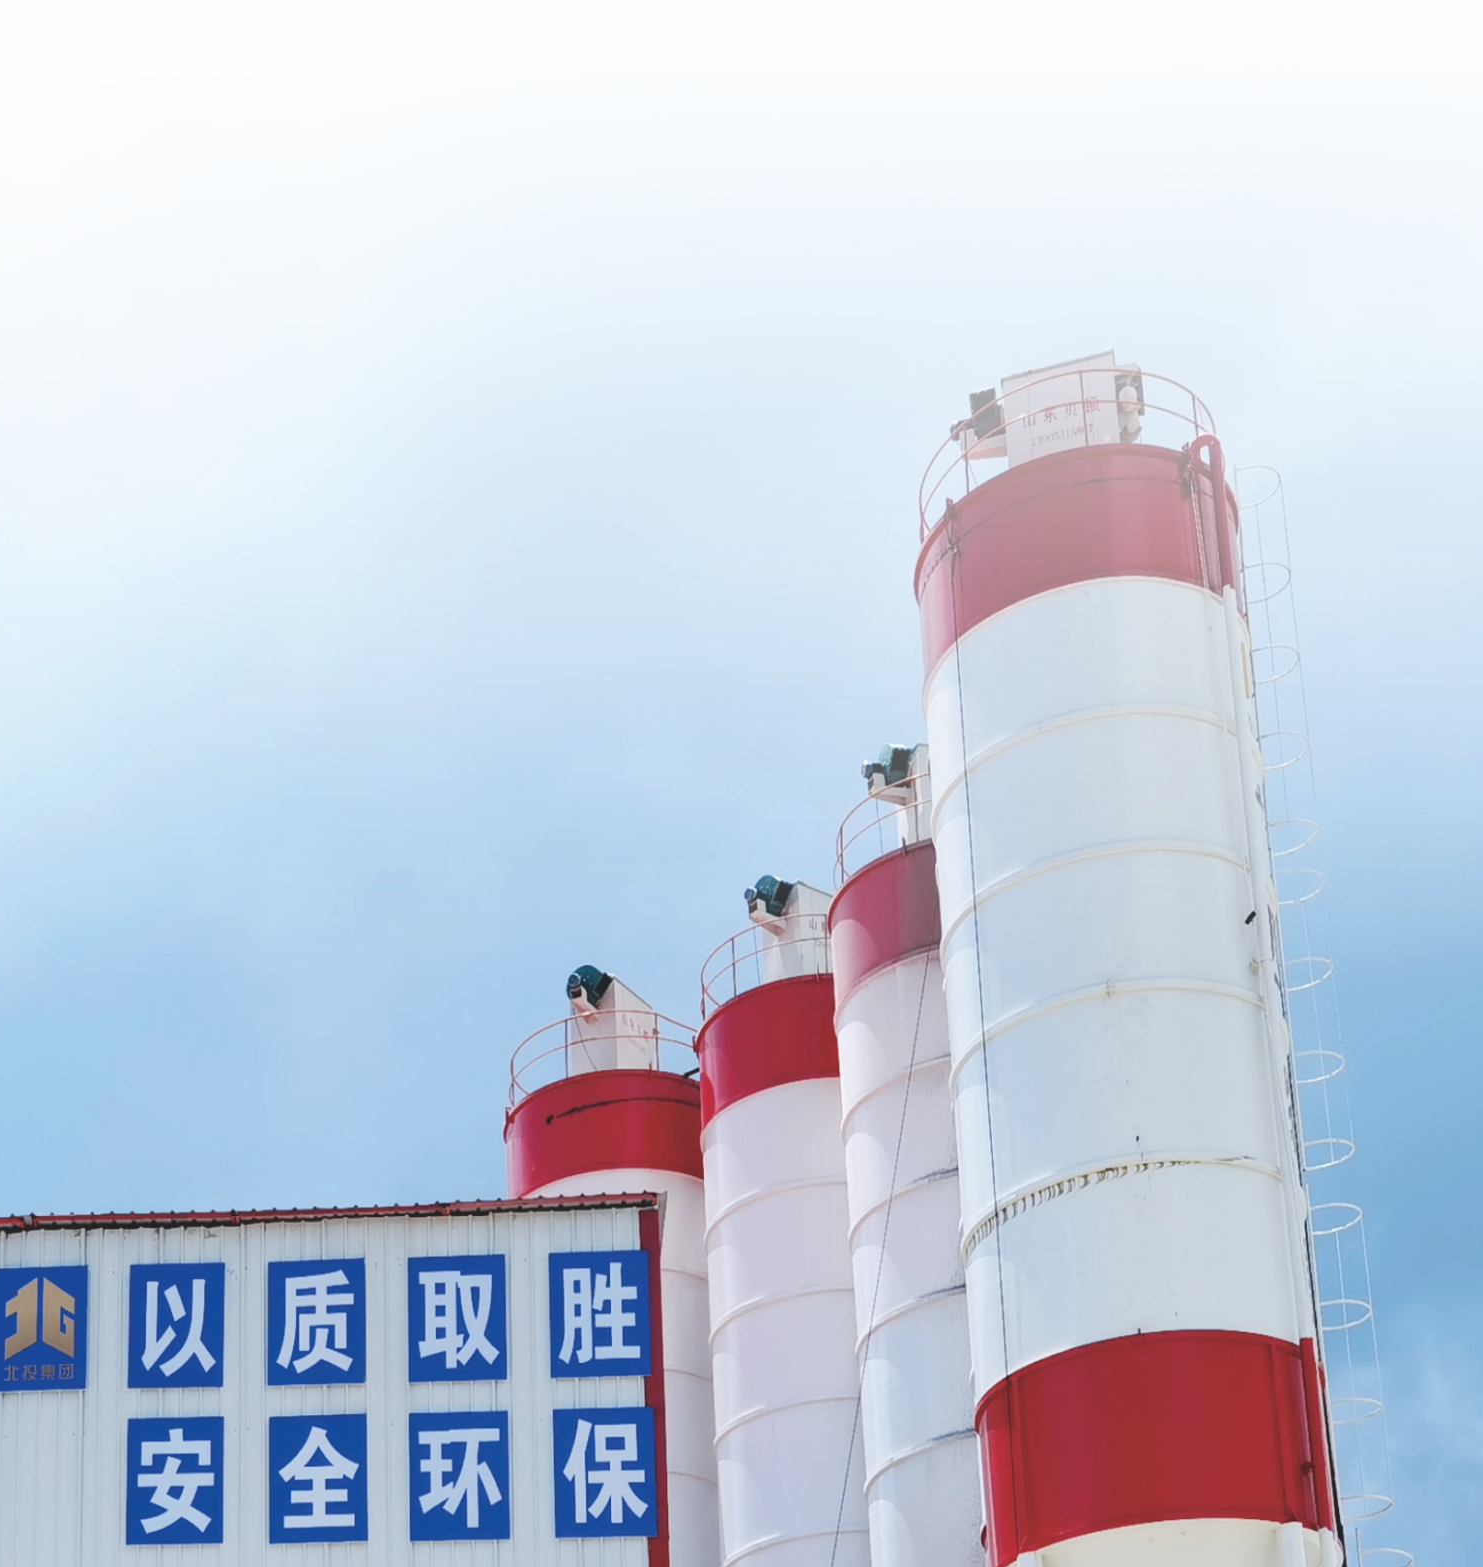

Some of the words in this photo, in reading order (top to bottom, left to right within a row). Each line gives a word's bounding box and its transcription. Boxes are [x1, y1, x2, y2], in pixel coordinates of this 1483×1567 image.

[4, 1364, 74, 1381] 北投集团
[141, 1262, 641, 1377] 以质取胜
[137, 1418, 649, 1534] 安全环保
